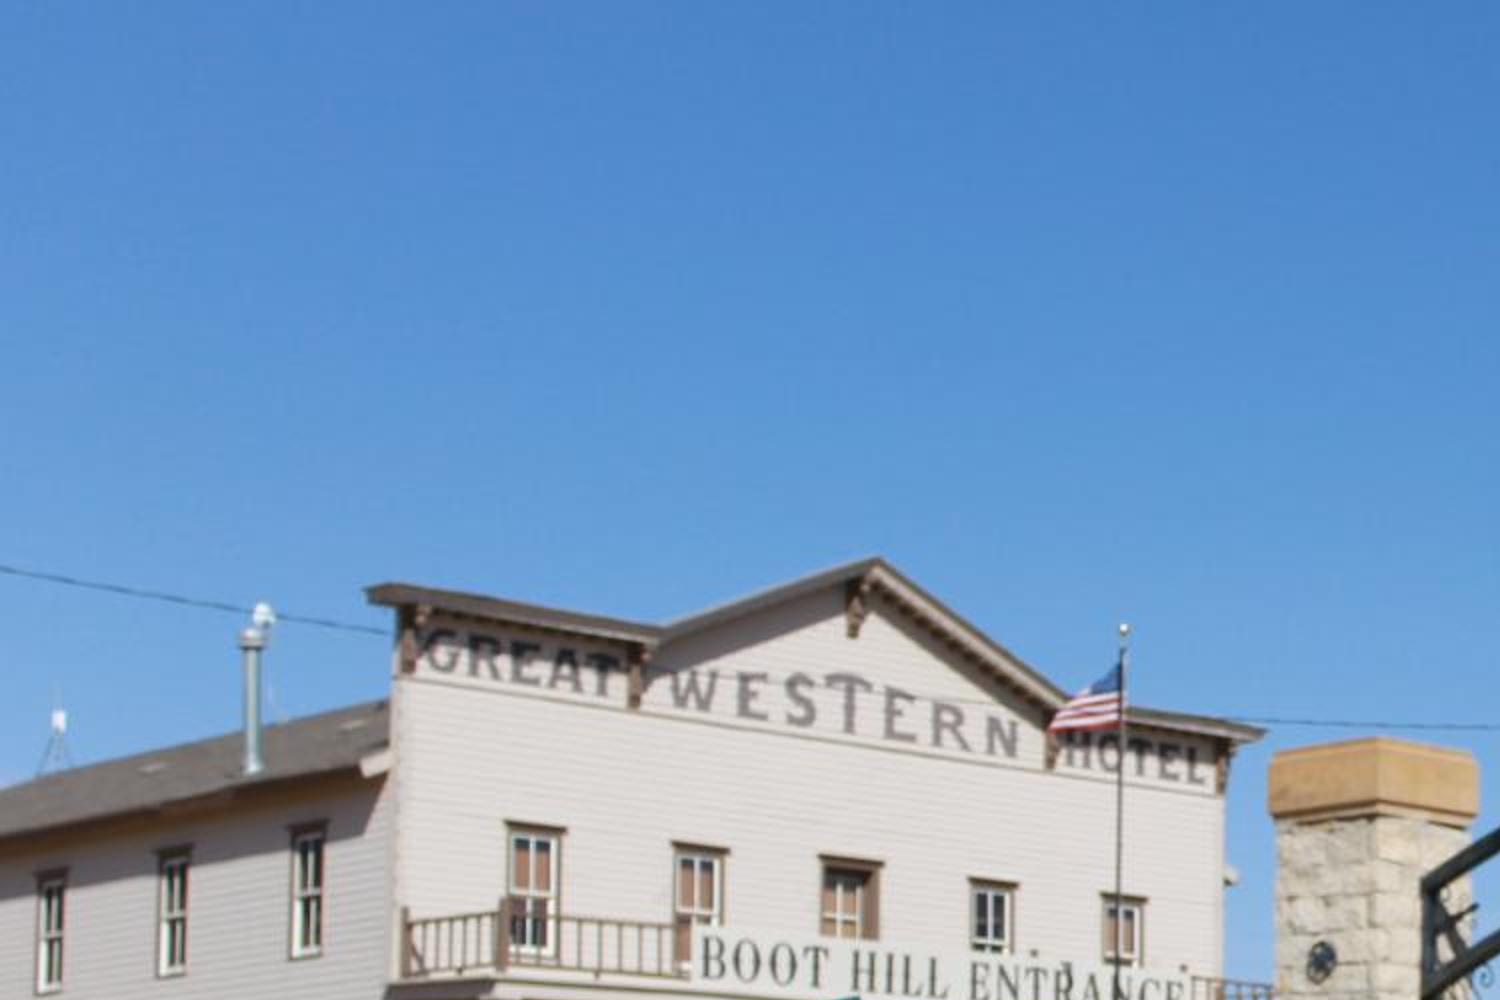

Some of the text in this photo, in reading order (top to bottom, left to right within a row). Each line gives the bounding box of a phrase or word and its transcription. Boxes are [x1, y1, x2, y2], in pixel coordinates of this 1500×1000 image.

[424, 629, 1205, 784] GREAT WESTERN HOTEL
[701, 934, 829, 990] BOOT
[851, 949, 949, 999] HILL
